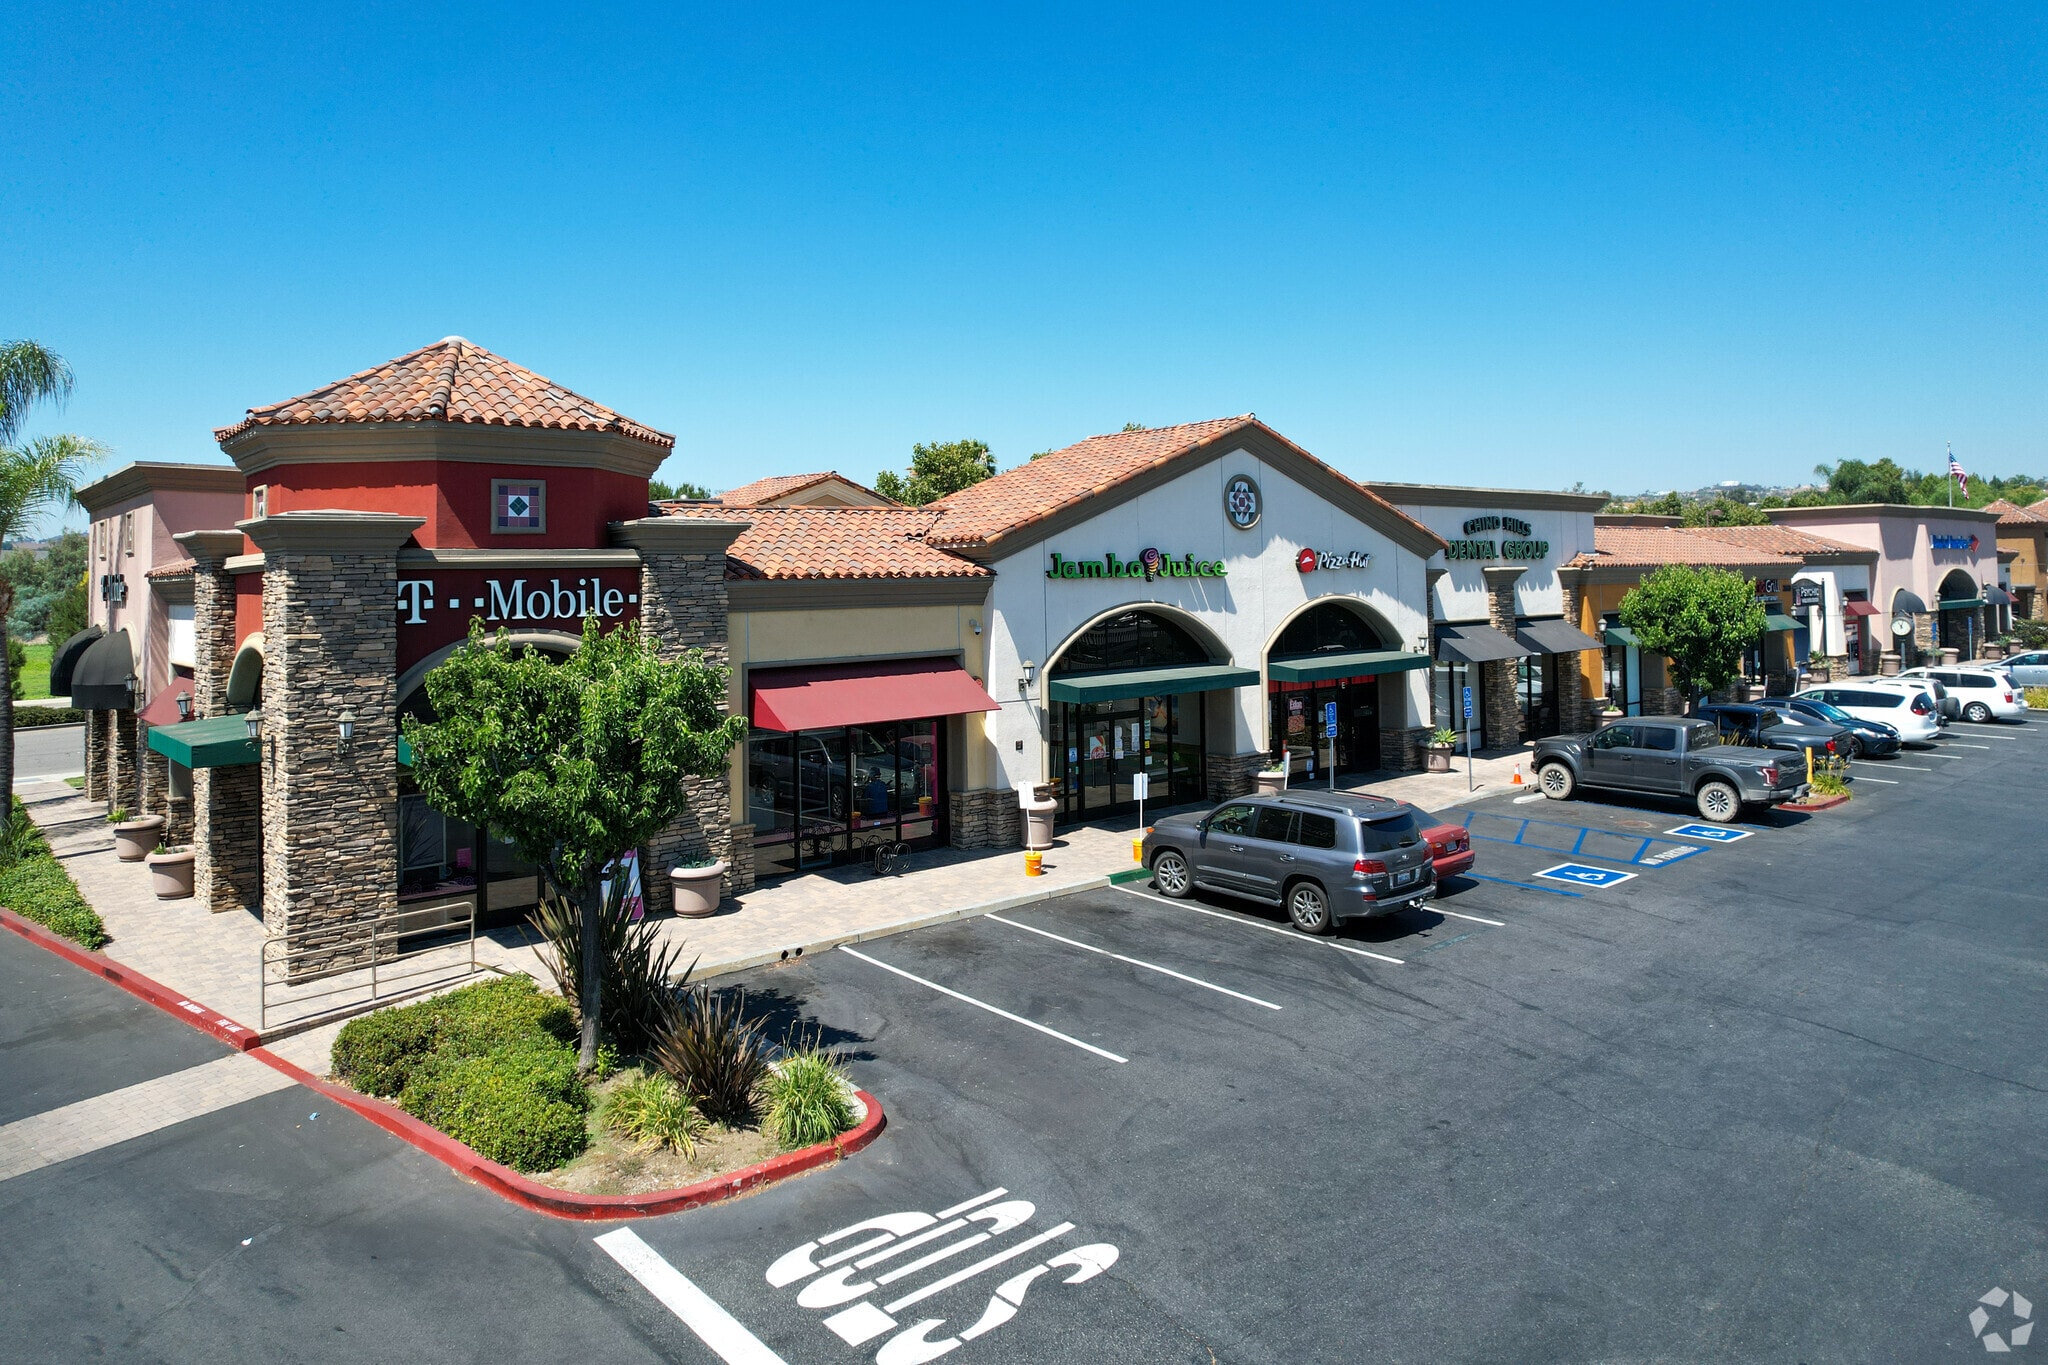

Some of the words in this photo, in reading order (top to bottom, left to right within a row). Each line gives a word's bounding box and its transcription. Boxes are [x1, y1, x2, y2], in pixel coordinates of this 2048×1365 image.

[1464, 516, 1501, 536] CHINO
[1502, 516, 1532, 537] HILLS
[1446, 540, 1499, 560] DENTAL
[1503, 540, 1550, 560] GROUP
[1047, 553, 1145, 579] Jamba
[1158, 553, 1228, 578] Juice
[1317, 551, 1349, 570] Pizza
[1349, 551, 1370, 569] Hut
